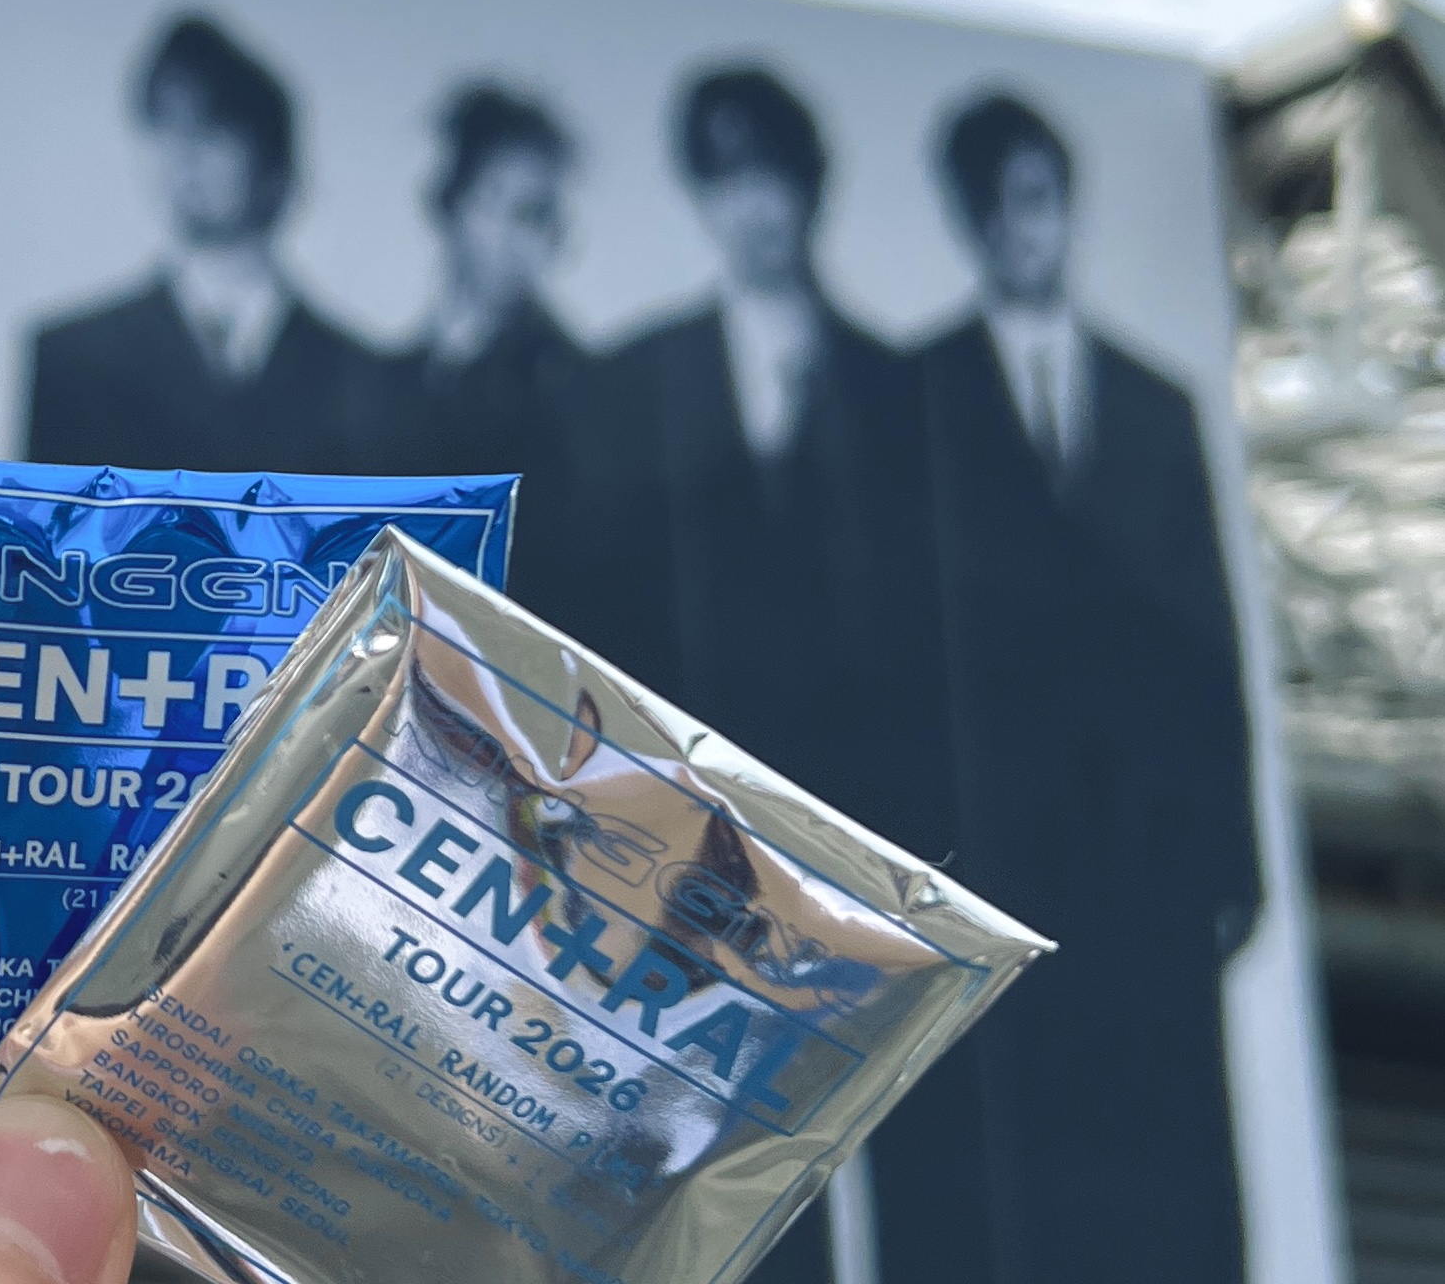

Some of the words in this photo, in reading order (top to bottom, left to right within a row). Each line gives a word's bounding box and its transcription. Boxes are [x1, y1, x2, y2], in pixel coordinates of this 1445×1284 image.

[334, 780, 803, 1112] CEN+RAL
[111, 1028, 221, 1105] SAPPORO
[127, 1006, 258, 1100] HIROSHIMA
[265, 1096, 337, 1149] CHIBA
[147, 986, 232, 1049] SENDAI
[237, 1045, 319, 1106] OSAKA
[383, 926, 513, 1032] TOUR
[511, 1018, 648, 1112] 2026
[78, 1068, 147, 1119] TAIPEI
[154, 1116, 273, 1199] SHANGHAI
[93, 1048, 208, 1127] BANGKOK
[284, 1167, 351, 1217] KONG
[437, 1048, 558, 1133] RANDOM
